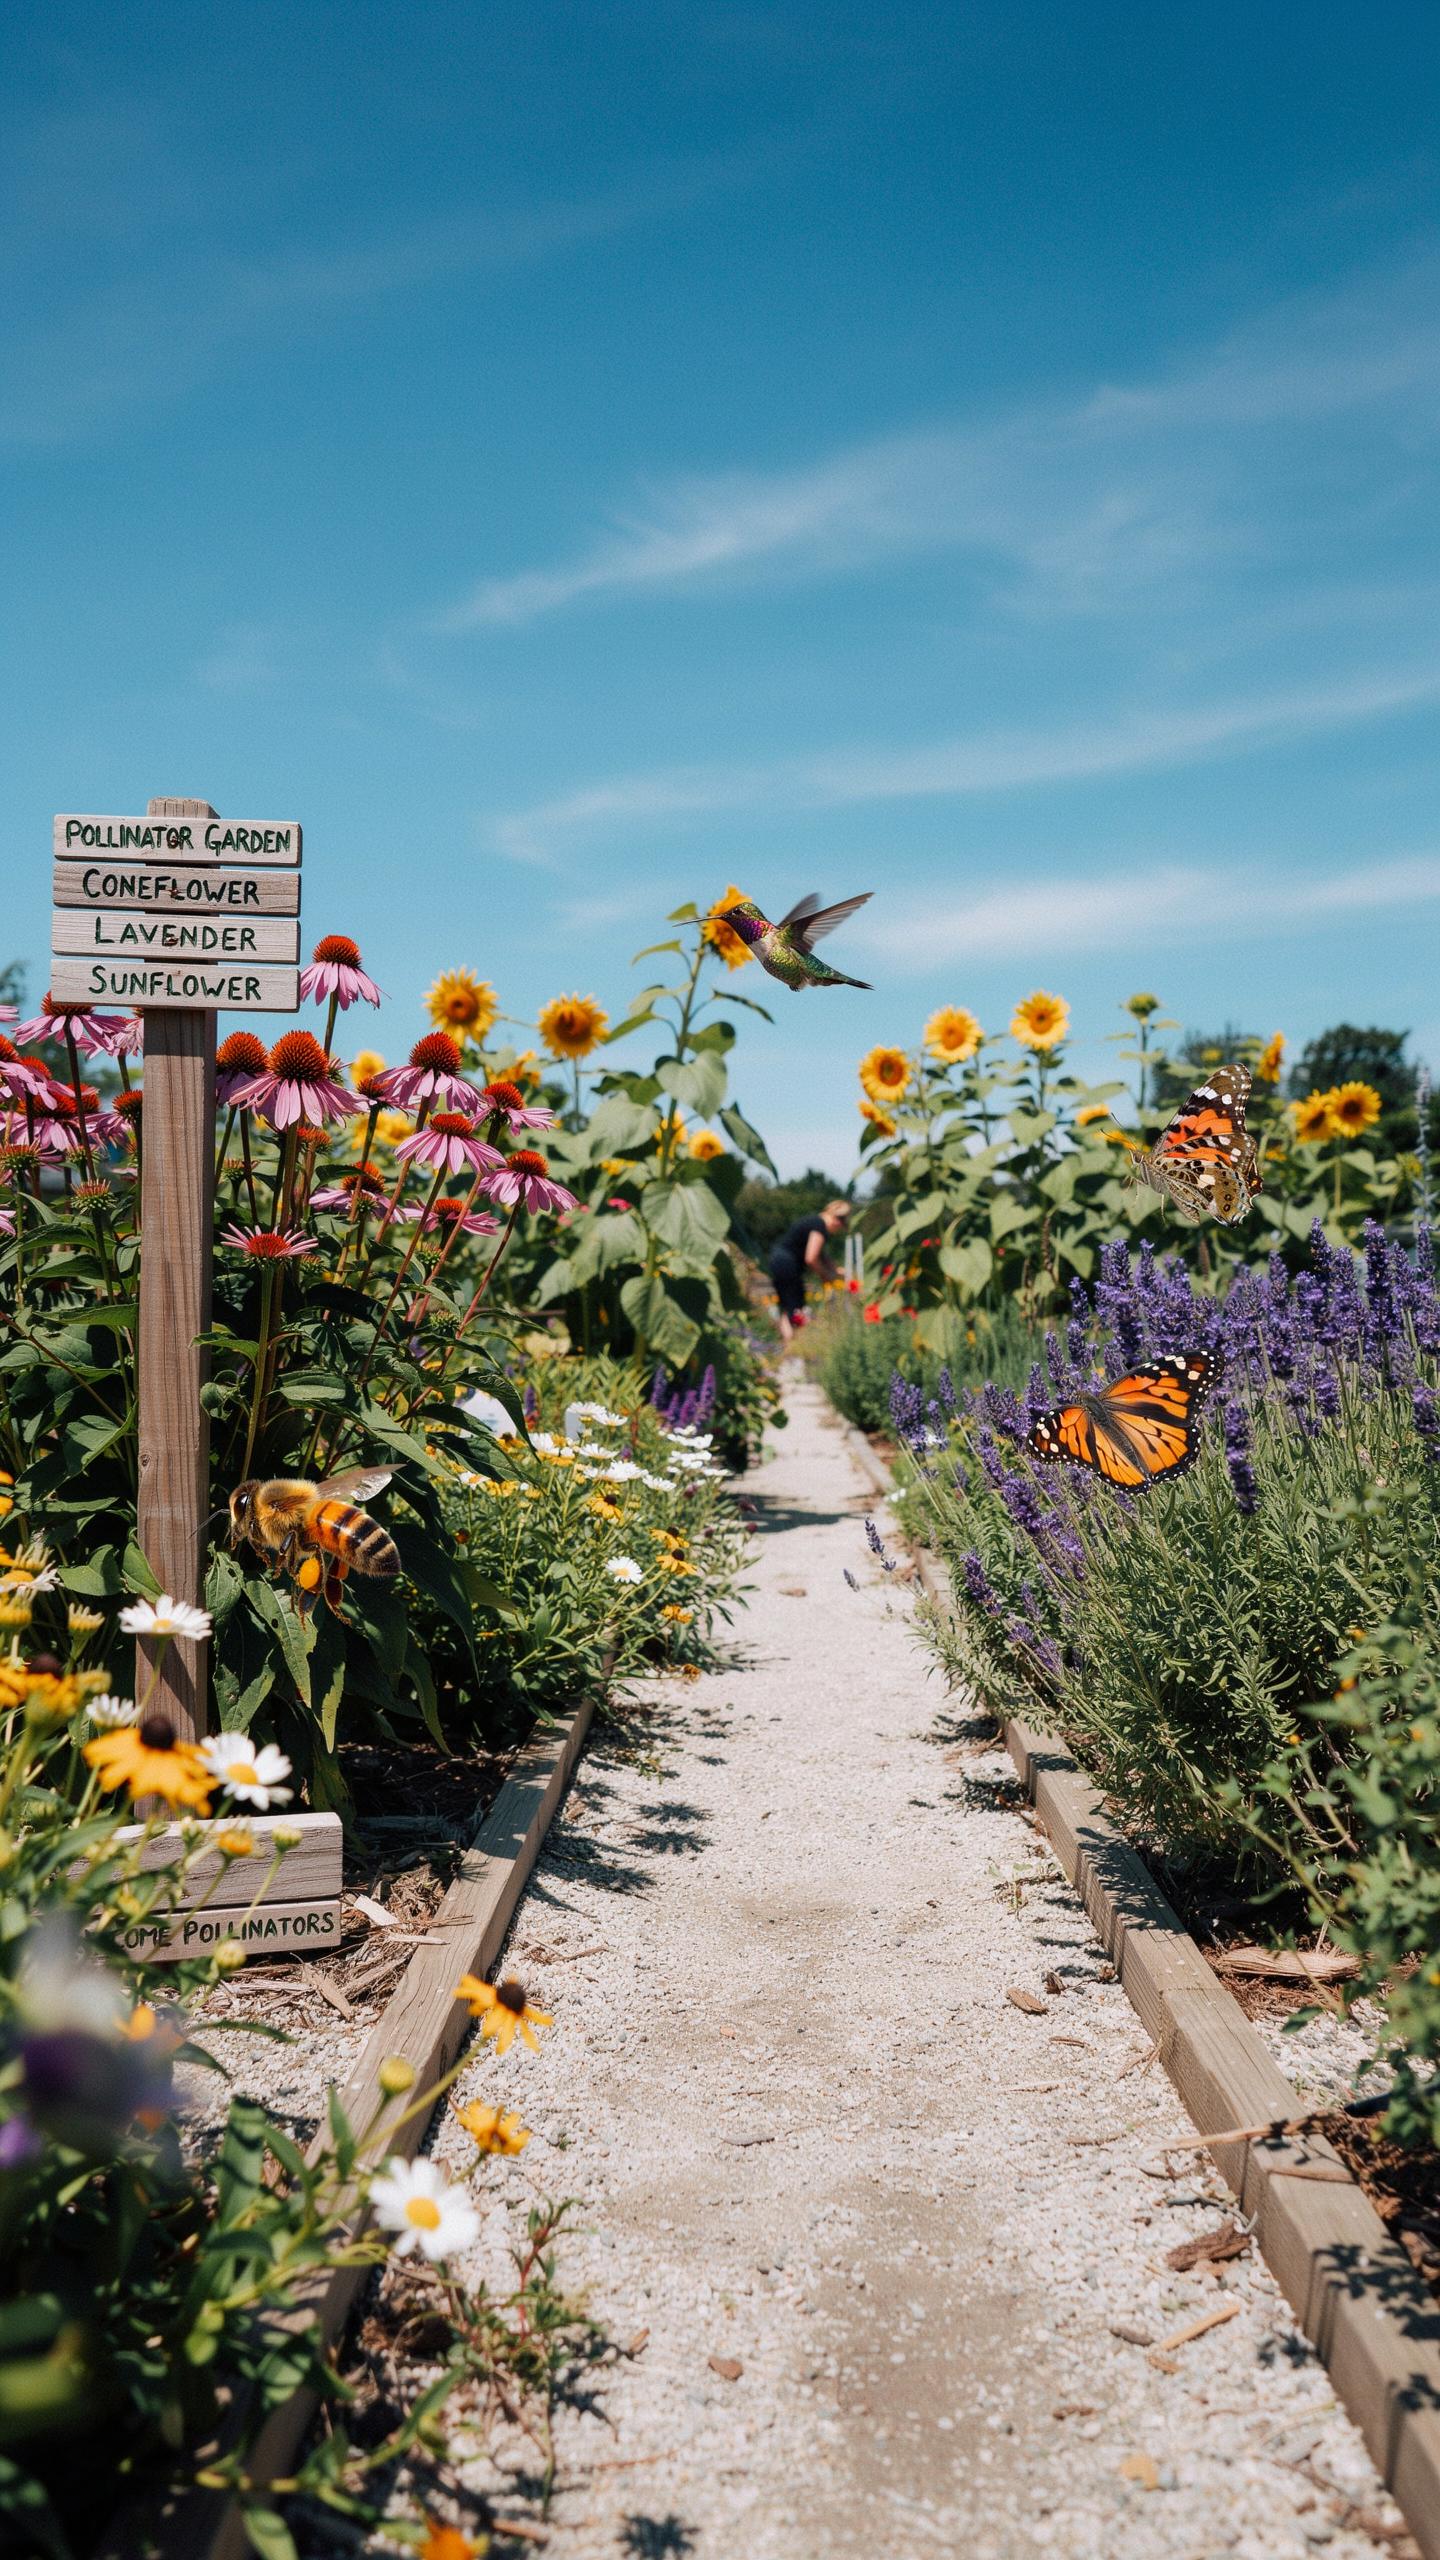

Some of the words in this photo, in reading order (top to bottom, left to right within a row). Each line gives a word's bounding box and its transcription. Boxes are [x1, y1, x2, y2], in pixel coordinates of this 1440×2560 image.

[66, 820, 194, 850] POLLINATOR
[205, 824, 291, 857] GARDEN
[82, 868, 260, 905] CONEFLOWER
[95, 916, 257, 951] LAVENDER
[88, 965, 262, 1000] SUNFLOWER
